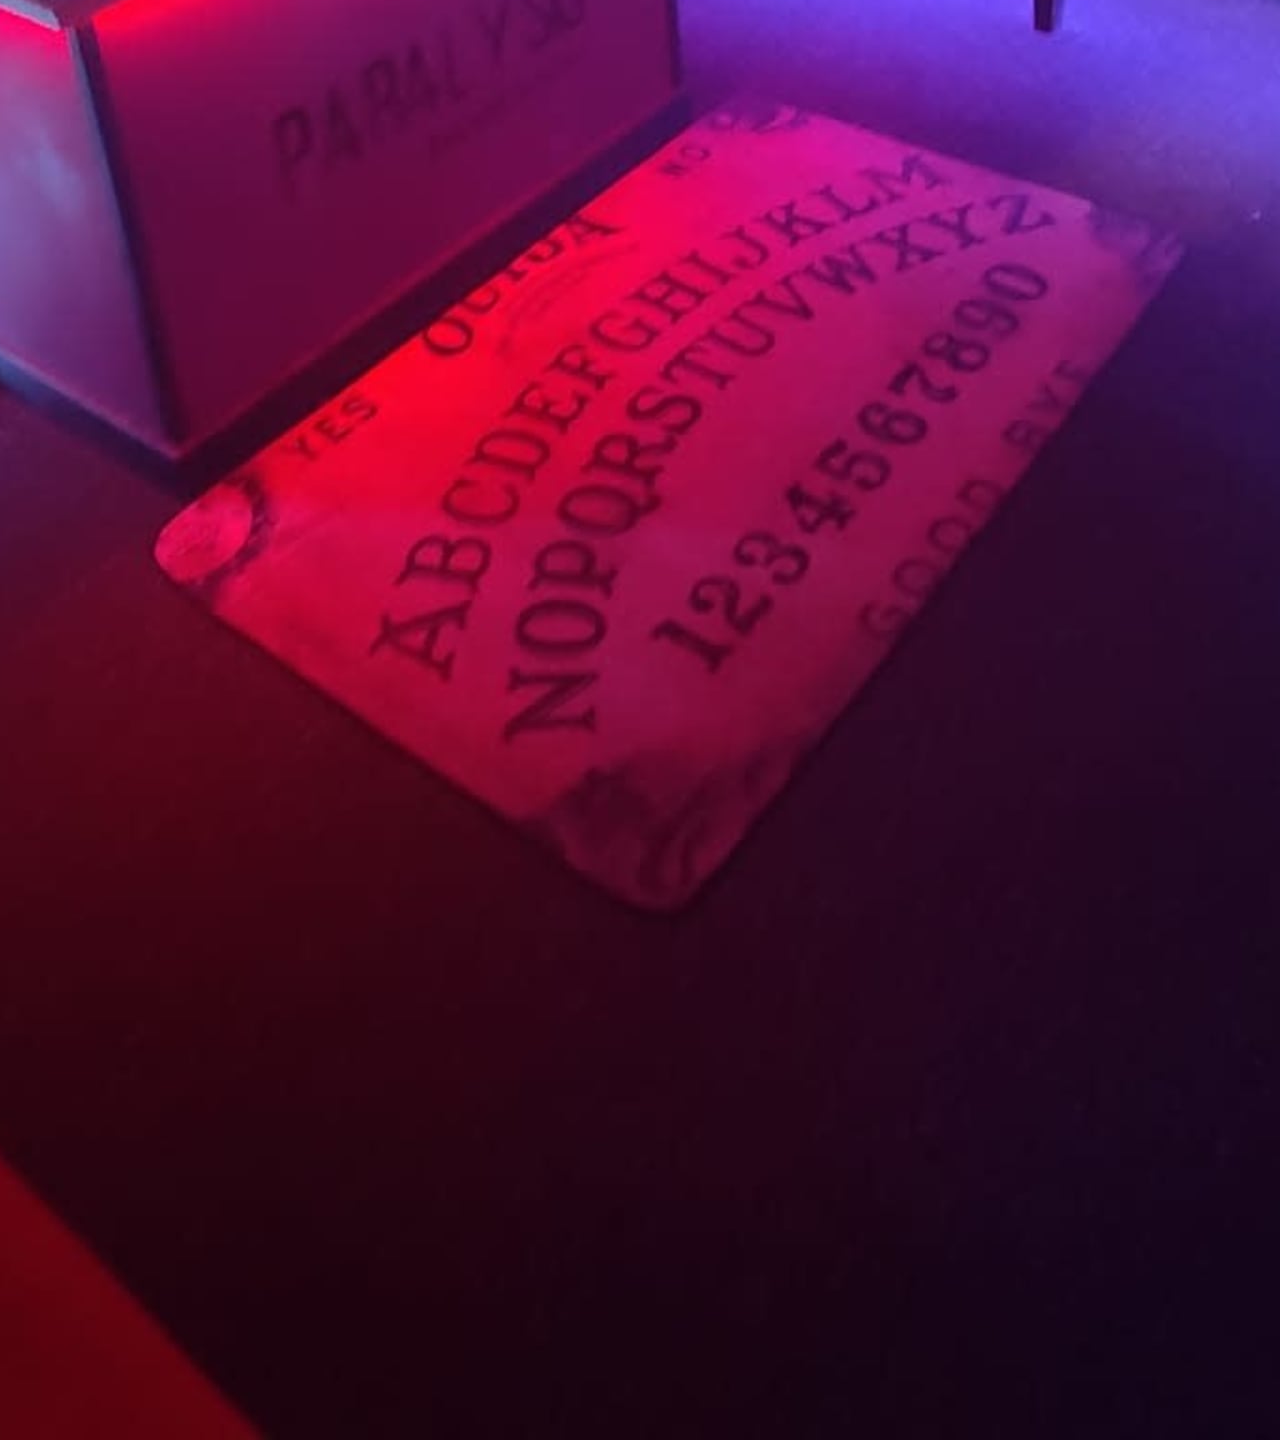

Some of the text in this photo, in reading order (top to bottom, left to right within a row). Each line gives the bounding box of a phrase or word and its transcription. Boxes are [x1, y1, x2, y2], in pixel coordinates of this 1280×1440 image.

[658, 144, 711, 179] NO
[283, 394, 380, 466] YES
[368, 152, 958, 682] ABCDEFGHIJKLM
[503, 192, 1058, 745] NOPQRSTUVWXYZ
[651, 258, 1052, 674] 1234567890
[858, 476, 1008, 640] GOOD
